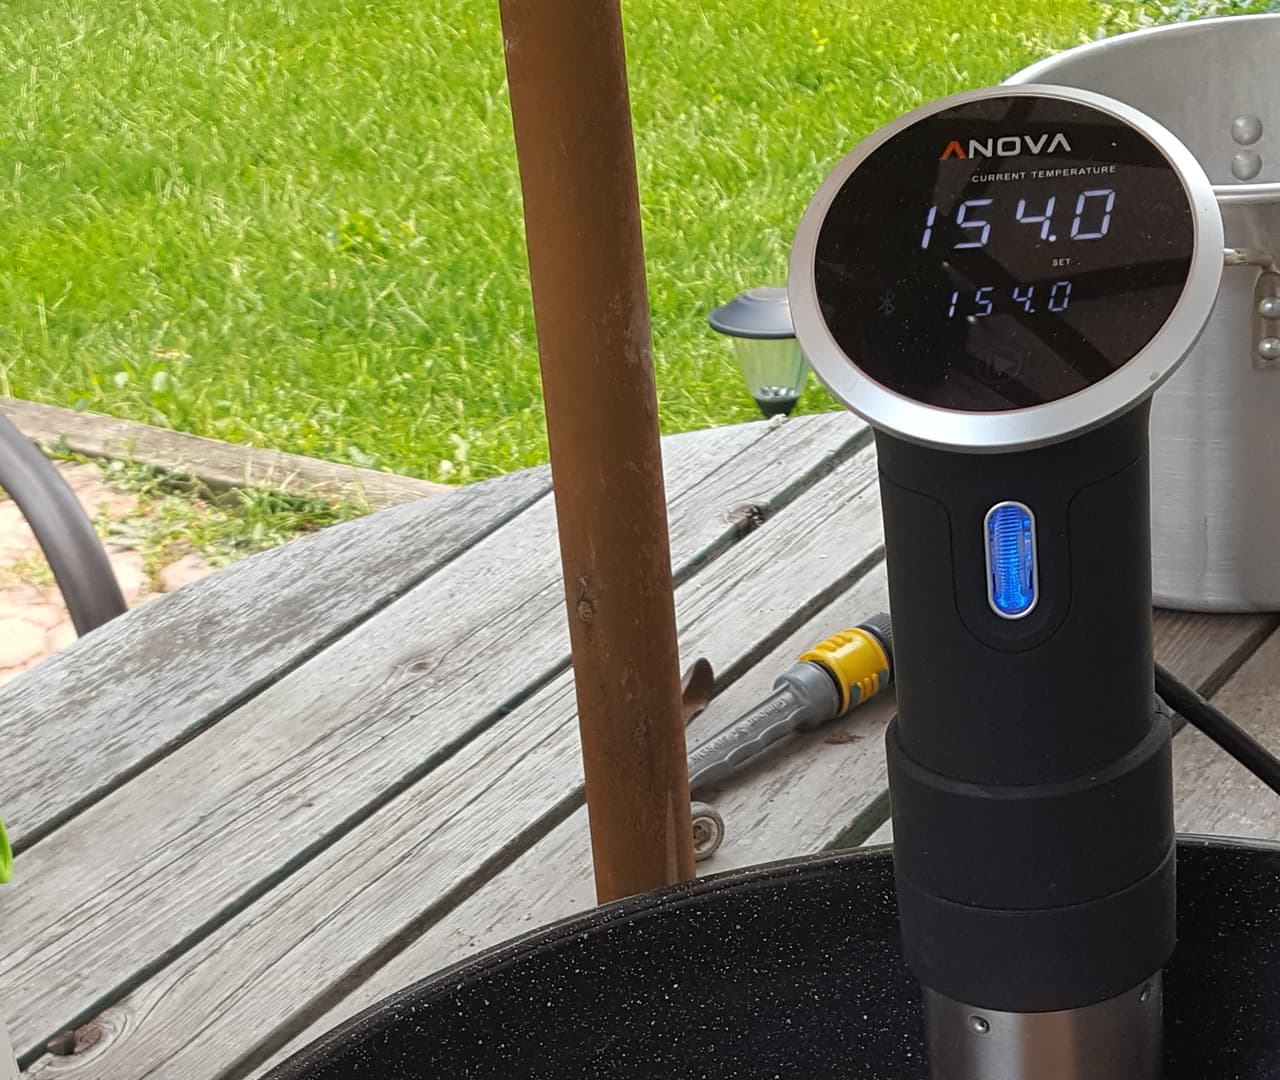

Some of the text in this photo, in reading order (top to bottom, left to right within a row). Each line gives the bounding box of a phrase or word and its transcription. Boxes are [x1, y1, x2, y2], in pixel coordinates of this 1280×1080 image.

[940, 133, 1072, 161] ANOVA
[971, 165, 1117, 183] CURRENT TEMPERATURE
[920, 188, 1116, 249] 154.0
[1052, 258, 1071, 267] SET
[948, 281, 1072, 318] 154.0
